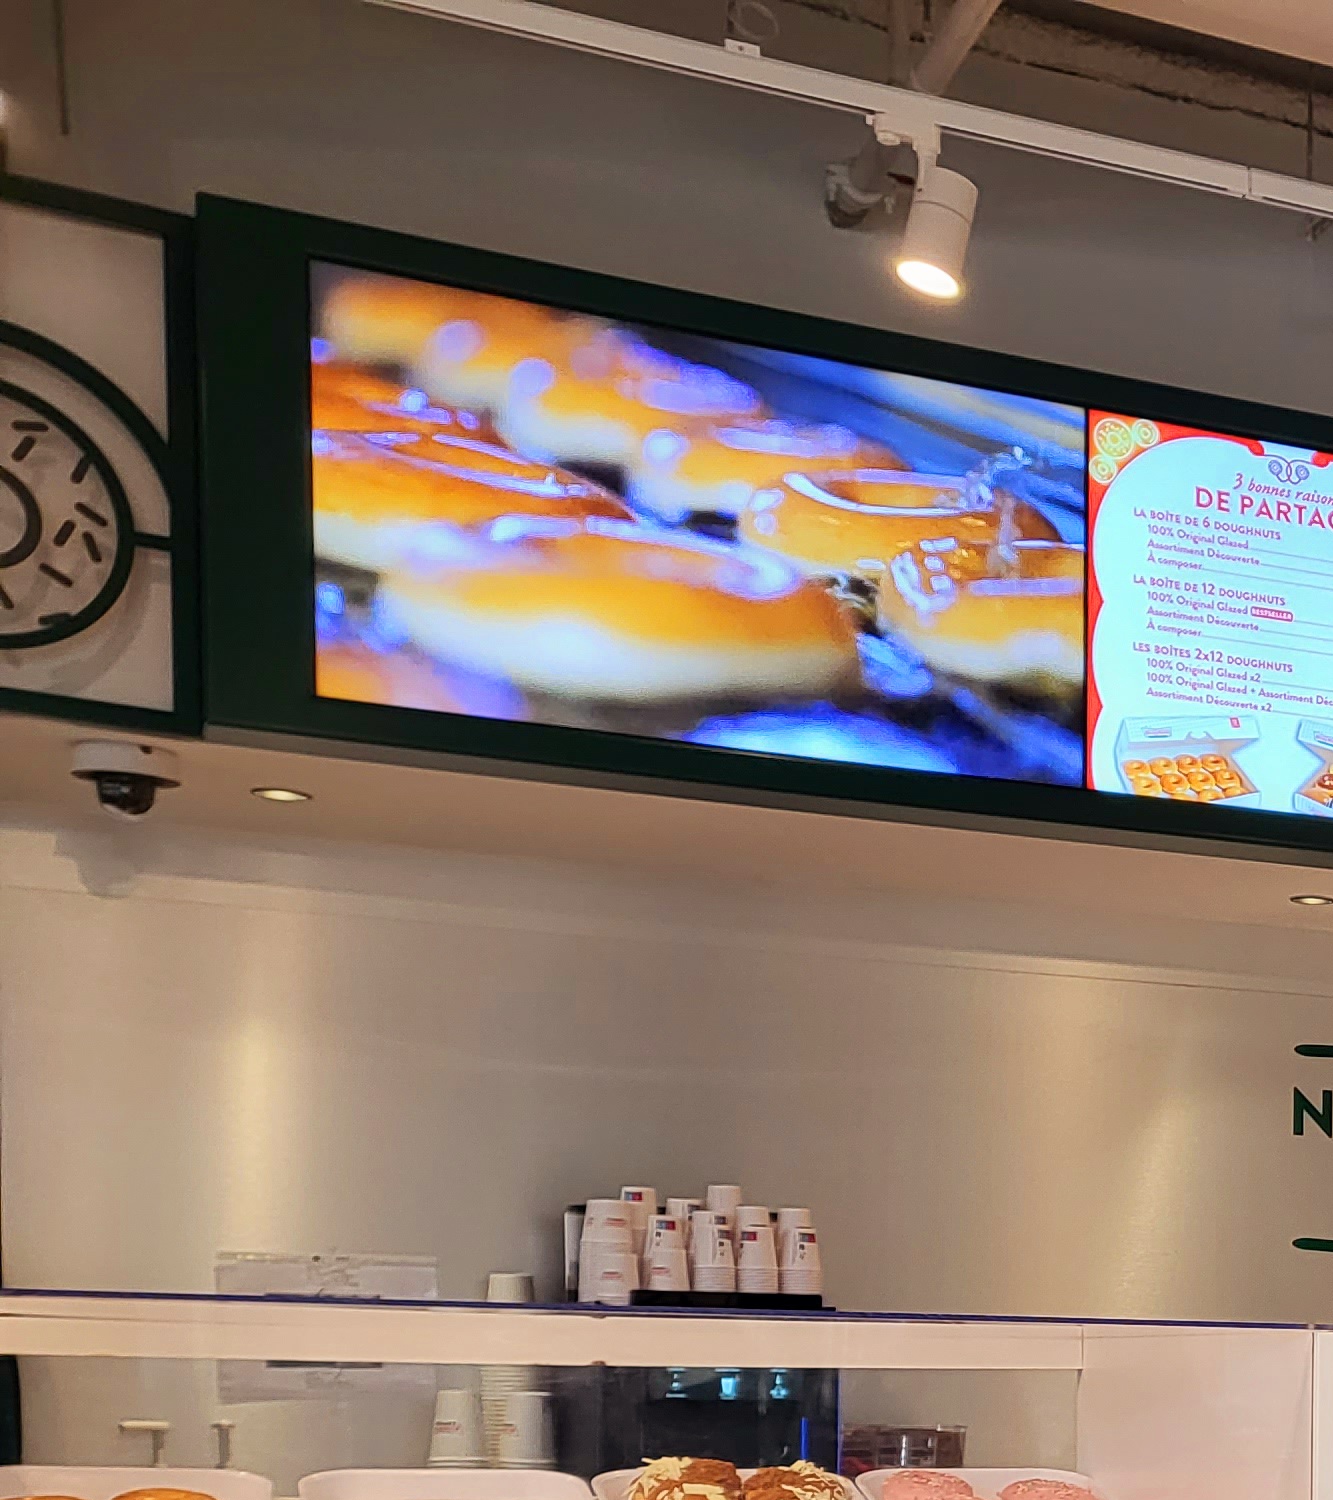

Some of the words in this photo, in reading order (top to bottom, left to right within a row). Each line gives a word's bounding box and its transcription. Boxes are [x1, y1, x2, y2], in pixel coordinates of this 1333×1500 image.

[1195, 486, 1230, 512] DE
[1233, 473, 1243, 490] 3
[1248, 478, 1291, 499] bonnes
[1134, 507, 1147, 518] LA
[1184, 516, 1198, 526] DE
[1202, 516, 1210, 528] 6
[1214, 521, 1281, 540] DOUGHNUTS
[1147, 524, 1174, 537] 100%
[1177, 529, 1215, 544] Original
[1217, 536, 1249, 549] Glazed
[1147, 539, 1205, 557] Assortiment
[1207, 547, 1260, 565] Découverte
[1158, 557, 1202, 570] composer
[1133, 574, 1146, 585] LA
[1184, 582, 1198, 593] DE
[1201, 582, 1215, 596] 12
[1219, 587, 1286, 606] DOUGHNUTS
[1147, 591, 1174, 604] 100%
[1176, 595, 1214, 611] Original
[1217, 602, 1248, 615] Glazed
[1146, 606, 1204, 623] Assortiment
[1207, 614, 1259, 631] Découverte
[1157, 624, 1202, 636] composer
[1133, 642, 1150, 653] LES
[1195, 648, 1223, 663] 2x12
[1227, 655, 1293, 673] DOUGHNUTS
[1146, 658, 1173, 670] 100%
[1176, 662, 1214, 677] Original
[1216, 668, 1247, 681] Glazed
[1250, 673, 1261, 682] x2
[1146, 672, 1173, 685] 100%
[1176, 676, 1214, 691] Original
[1216, 682, 1247, 695] Glazed
[1258, 688, 1313, 705] Assortiment
[1146, 687, 1203, 703] Assortiment
[1206, 695, 1258, 711] Découverte
[1261, 703, 1272, 713] x2
